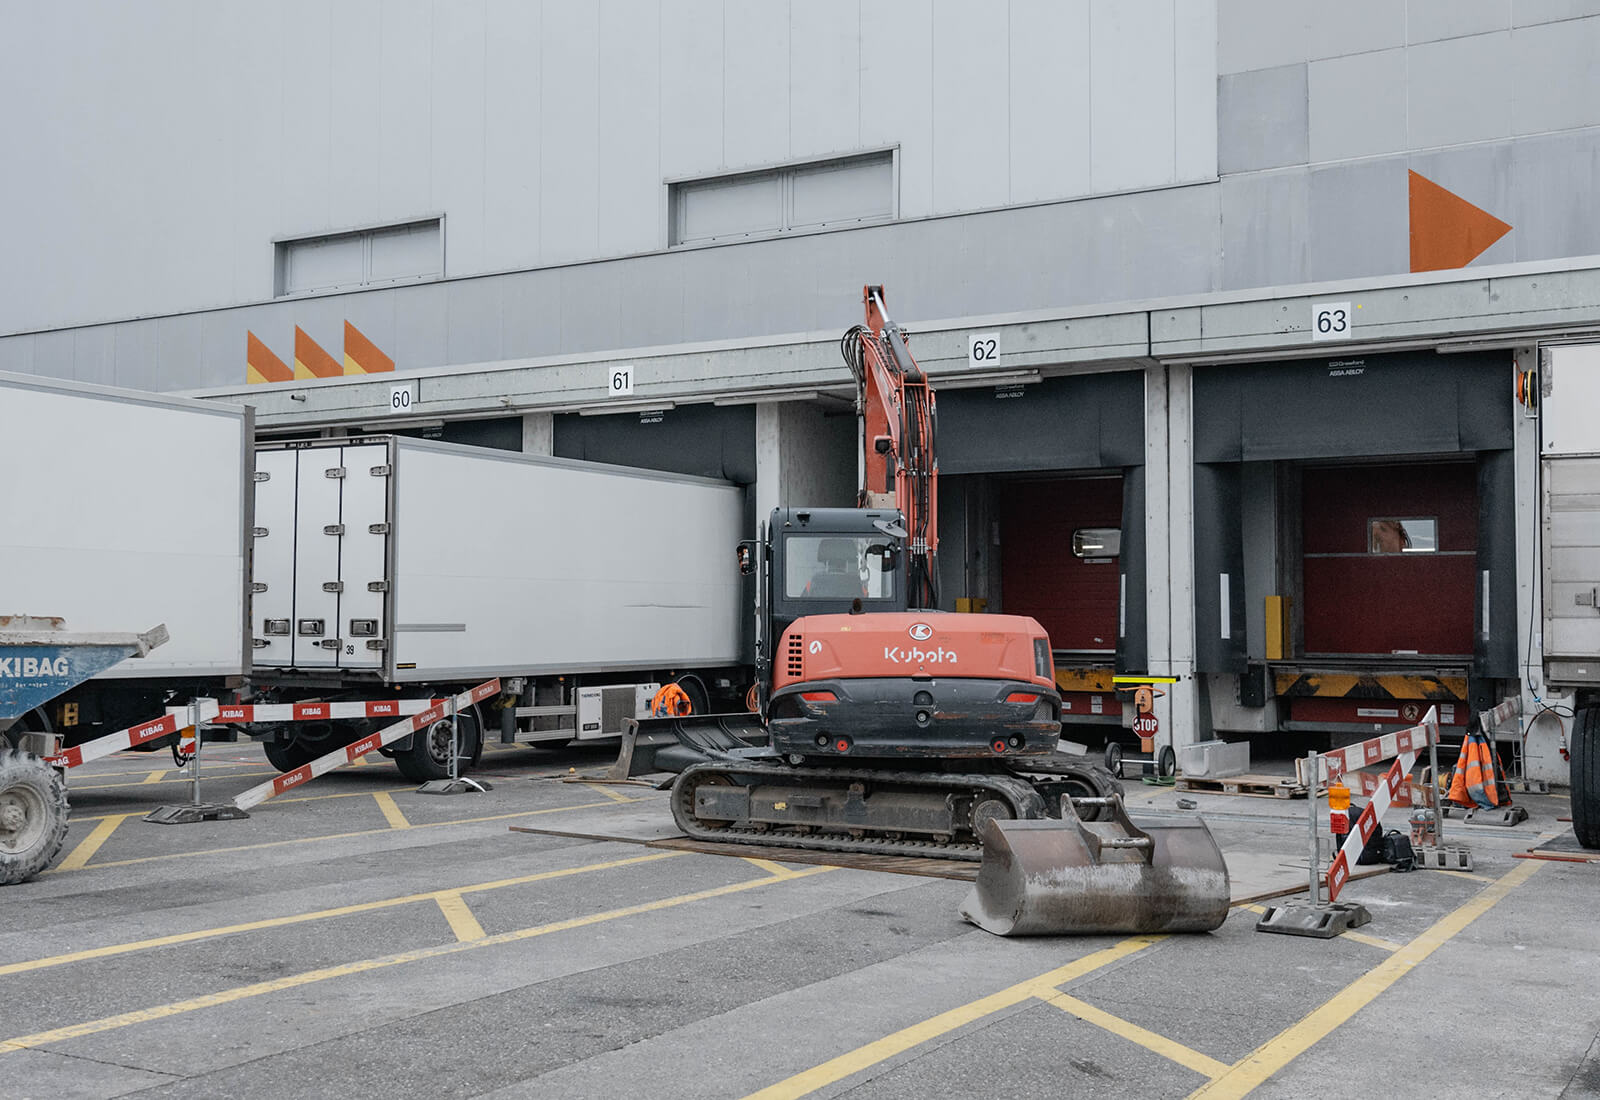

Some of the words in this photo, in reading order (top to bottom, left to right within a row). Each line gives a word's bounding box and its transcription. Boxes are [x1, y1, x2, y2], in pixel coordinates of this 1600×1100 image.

[1317, 309, 1347, 334] 63
[973, 339, 998, 361] 62
[613, 371, 629, 391] 61
[392, 390, 410, 409] 60
[346, 645, 355, 655] 39
[884, 646, 958, 664] Kubota
[0, 656, 70, 678] KIBAG
[222, 709, 244, 719] KIBAG
[301, 707, 322, 717] KIBAG
[373, 704, 392, 713] KIBAG
[139, 723, 164, 739] KIBAG
[1133, 718, 1158, 732] STOP
[51, 755, 70, 767] BAG
[282, 772, 304, 788] KIBAG
